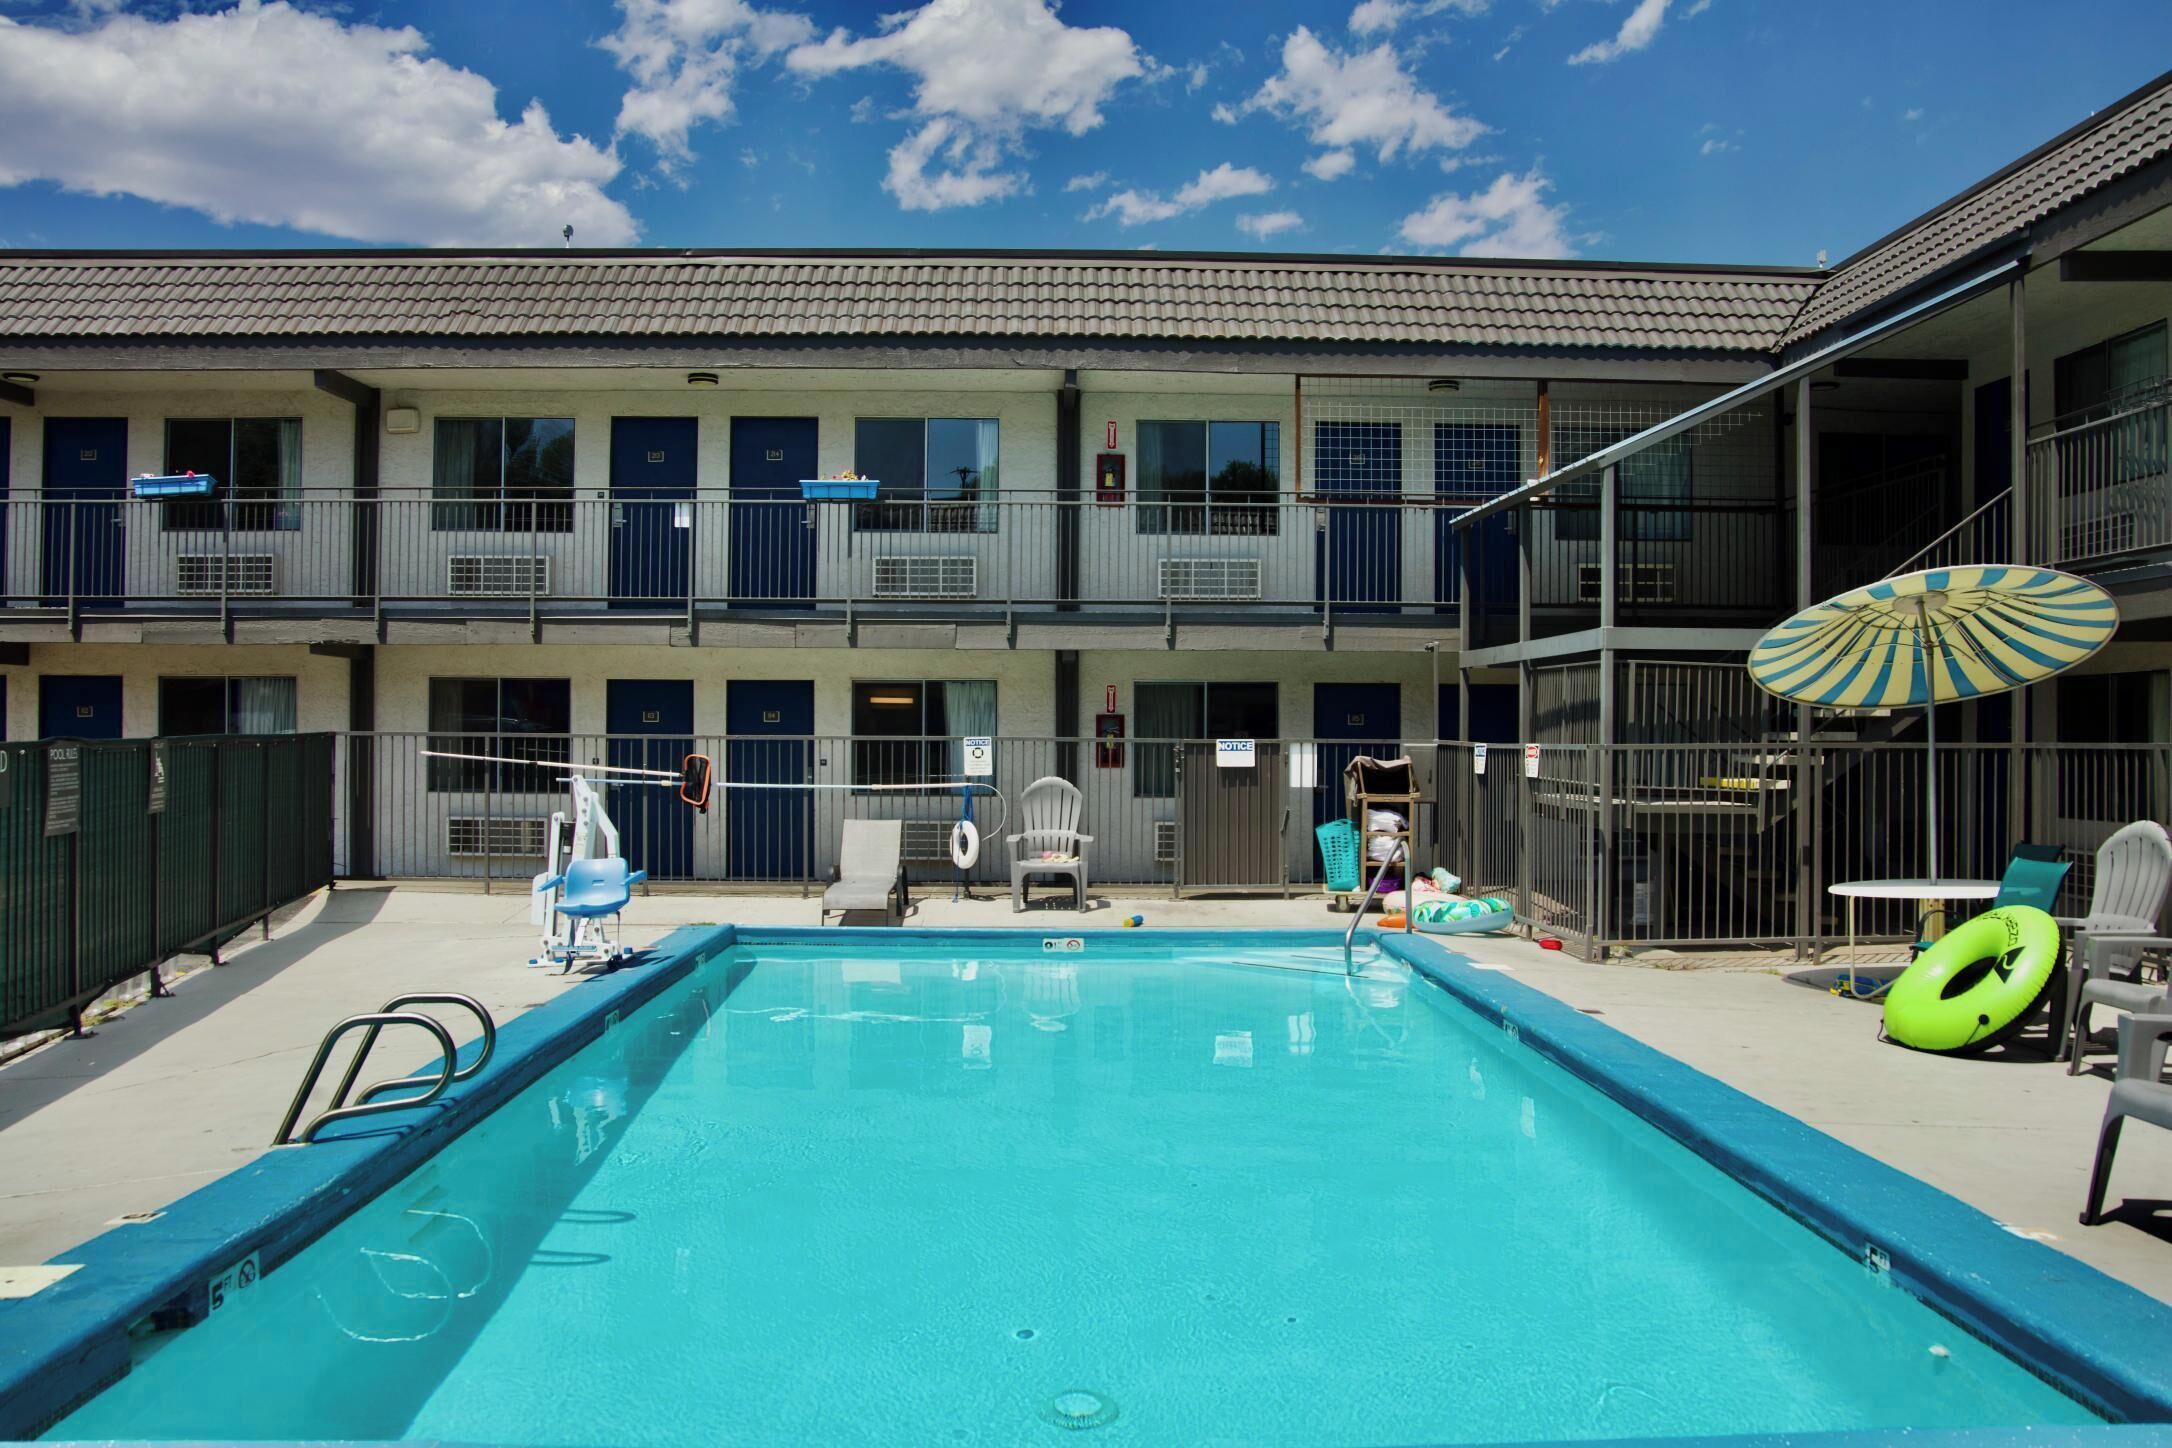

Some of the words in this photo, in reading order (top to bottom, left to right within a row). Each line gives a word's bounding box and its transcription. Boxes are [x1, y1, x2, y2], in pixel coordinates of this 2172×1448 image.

[1218, 742, 1253, 751] NOTICE
[50, 748, 66, 760] POOL
[211, 1281, 225, 1311] 5
[223, 1274, 233, 1291] FT
